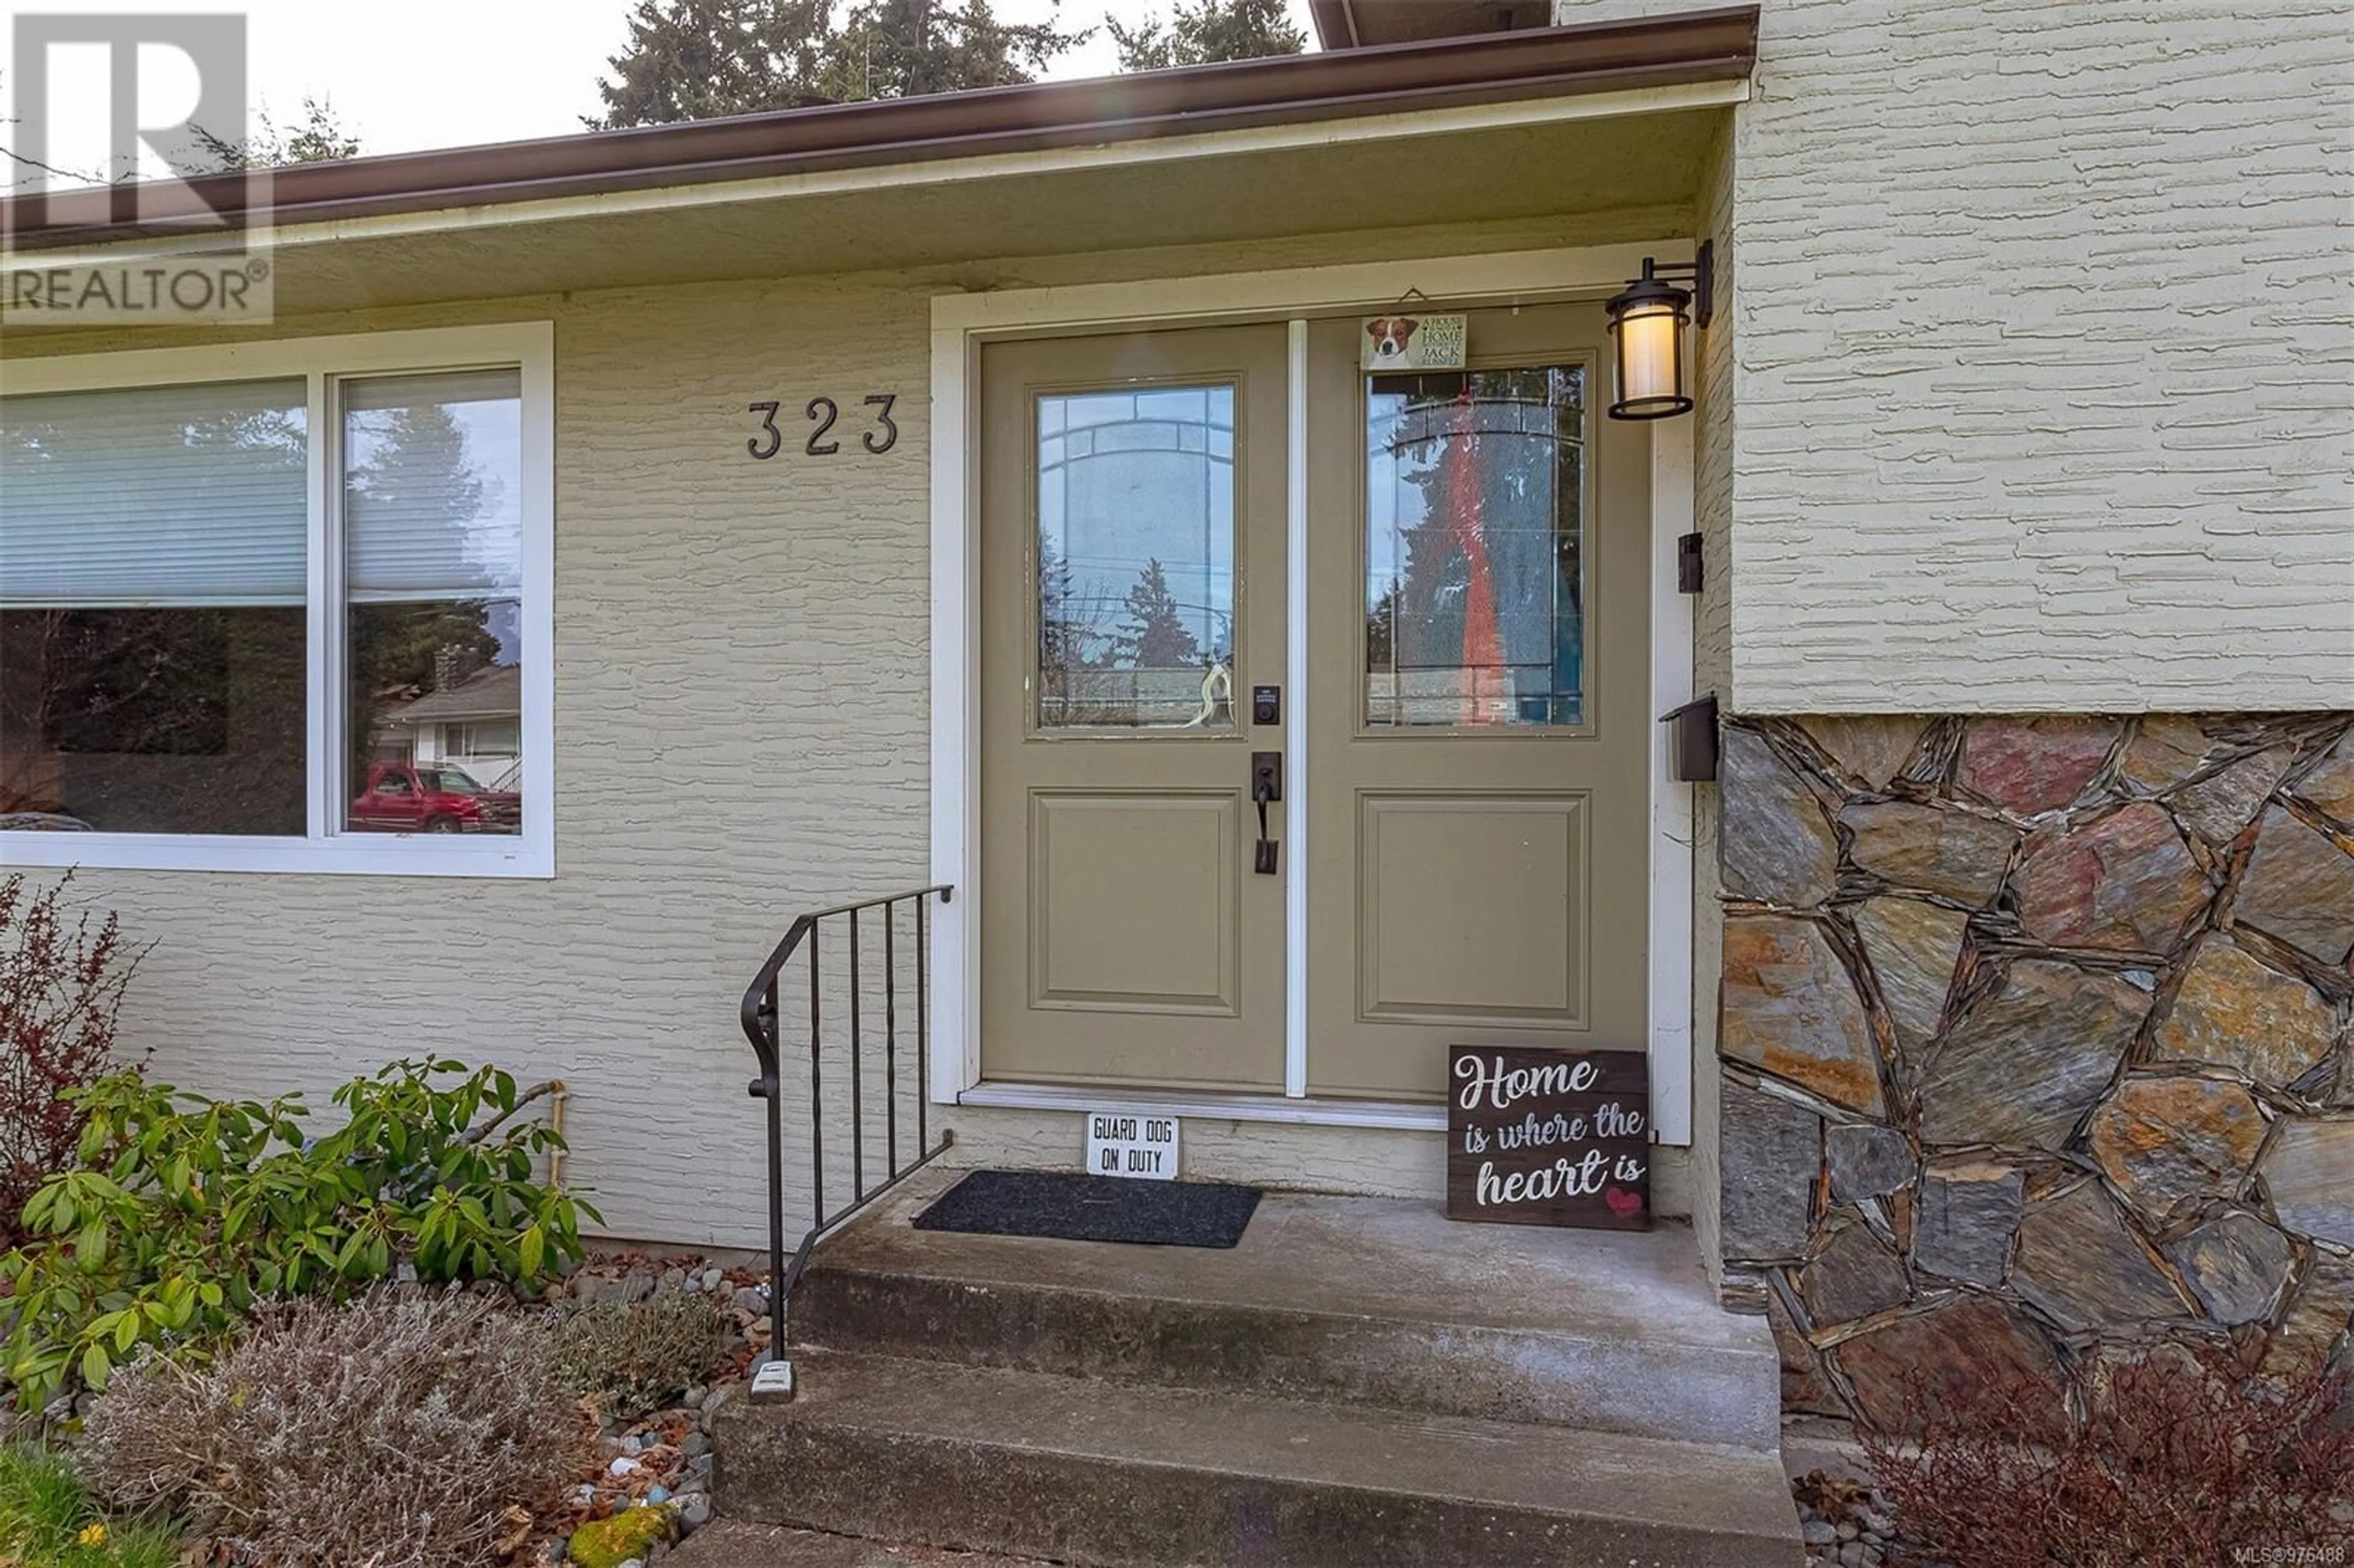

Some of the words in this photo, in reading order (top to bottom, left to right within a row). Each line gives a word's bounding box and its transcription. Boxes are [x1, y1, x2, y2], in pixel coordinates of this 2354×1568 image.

[1423, 330, 1462, 342] HOME
[1423, 346, 1460, 357] JACK
[747, 394, 897, 459] 323
[1455, 1055, 1598, 1110] Home
[1094, 1117, 1137, 1141] GUARD
[1146, 1120, 1172, 1143] DOG
[1465, 1124, 1490, 1154] is
[1498, 1113, 1587, 1149] where
[1593, 1102, 1645, 1138] the
[1102, 1147, 1119, 1170] ON
[1129, 1149, 1162, 1173] DUTY
[1477, 1149, 1610, 1206] heart
[1614, 1155, 1646, 1181] is
